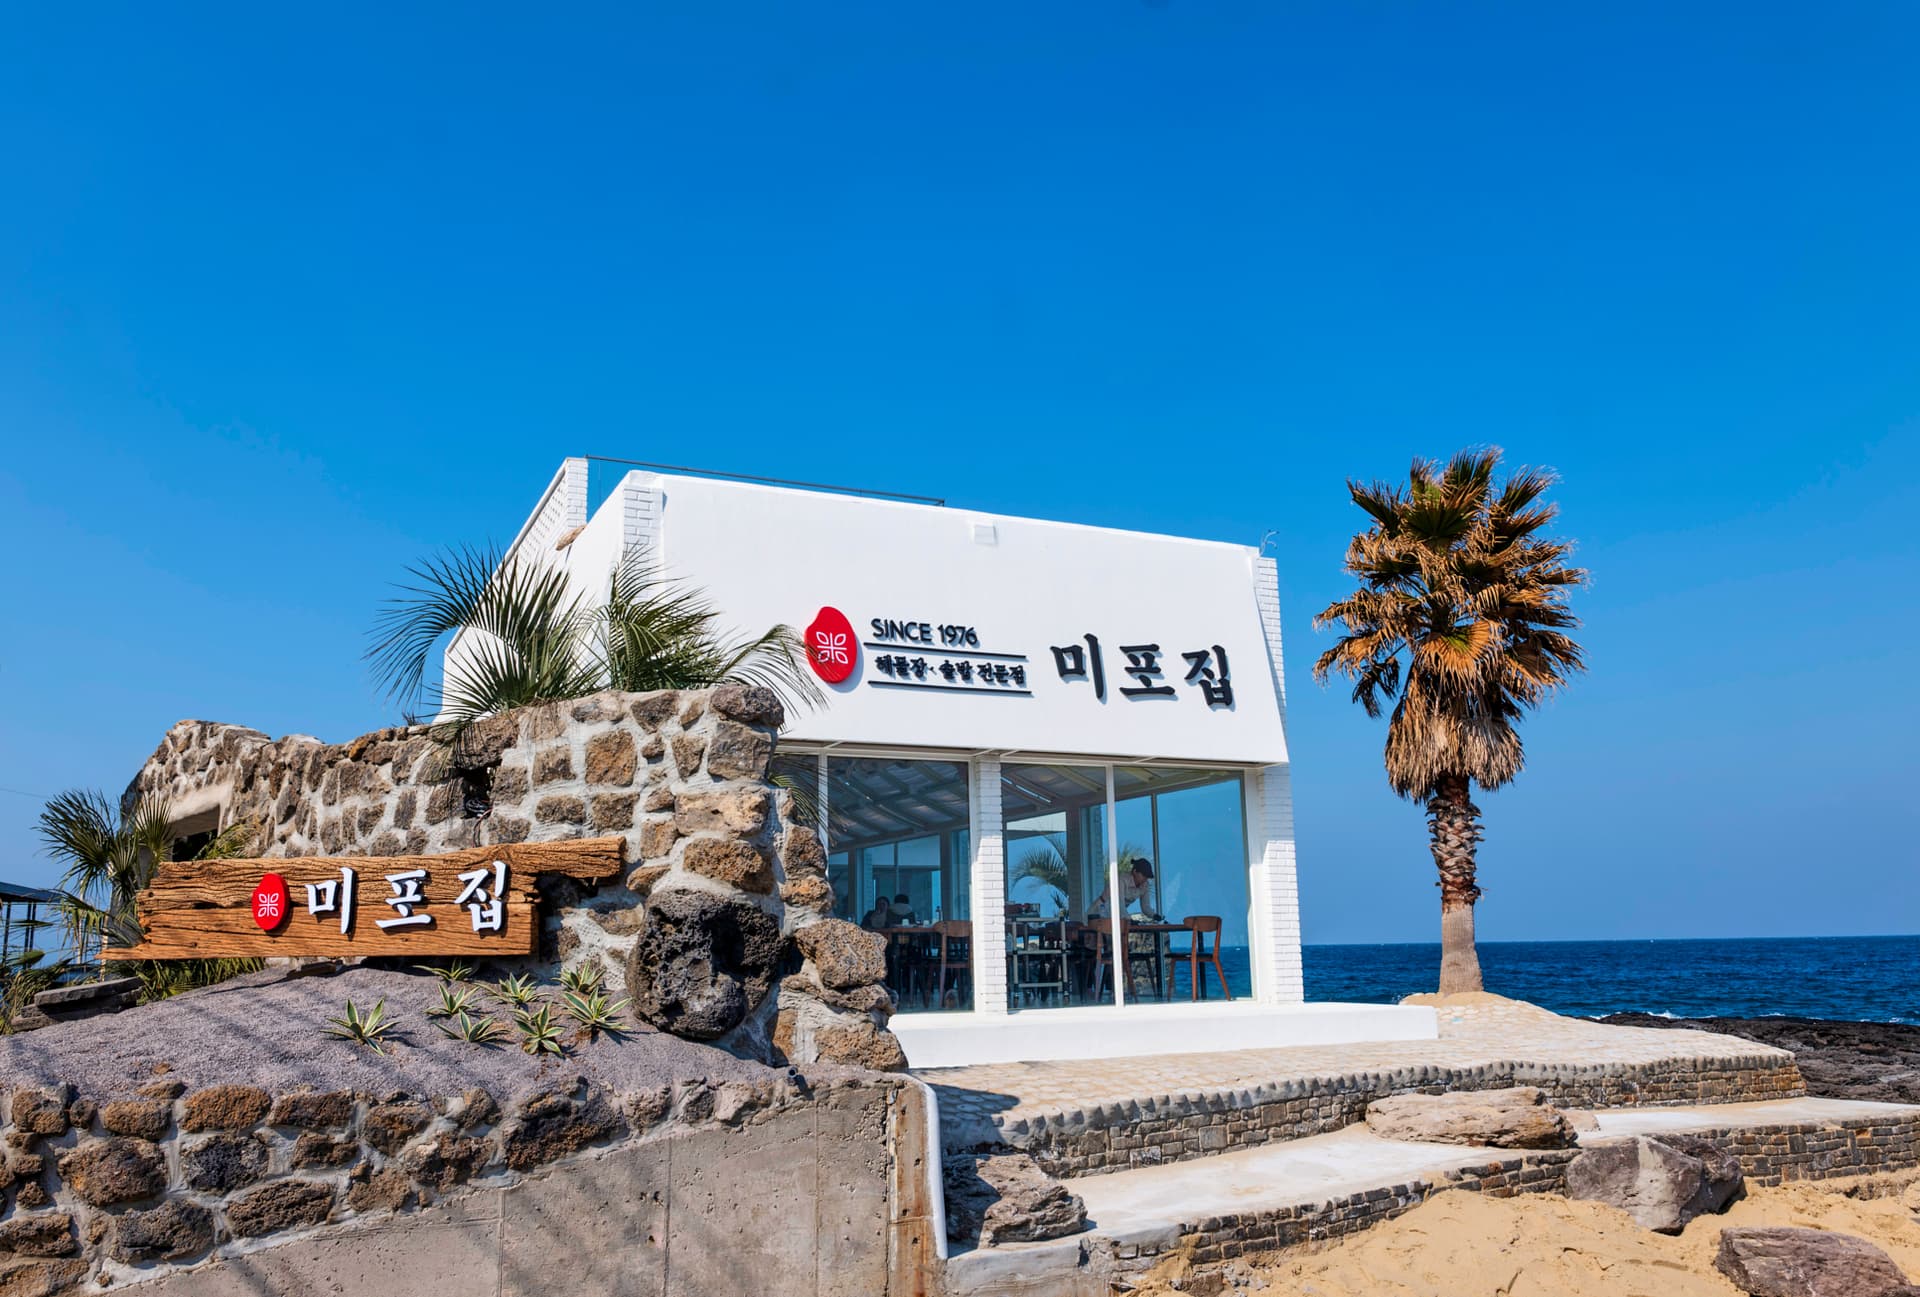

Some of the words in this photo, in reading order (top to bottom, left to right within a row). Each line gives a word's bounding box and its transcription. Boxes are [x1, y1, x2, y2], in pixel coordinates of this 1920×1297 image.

[870, 617, 933, 642] SINCE
[937, 623, 978, 646] 1976
[976, 662, 1025, 685] 전문점
[1050, 633, 1233, 706] 미포집
[304, 860, 507, 934] 미포집
